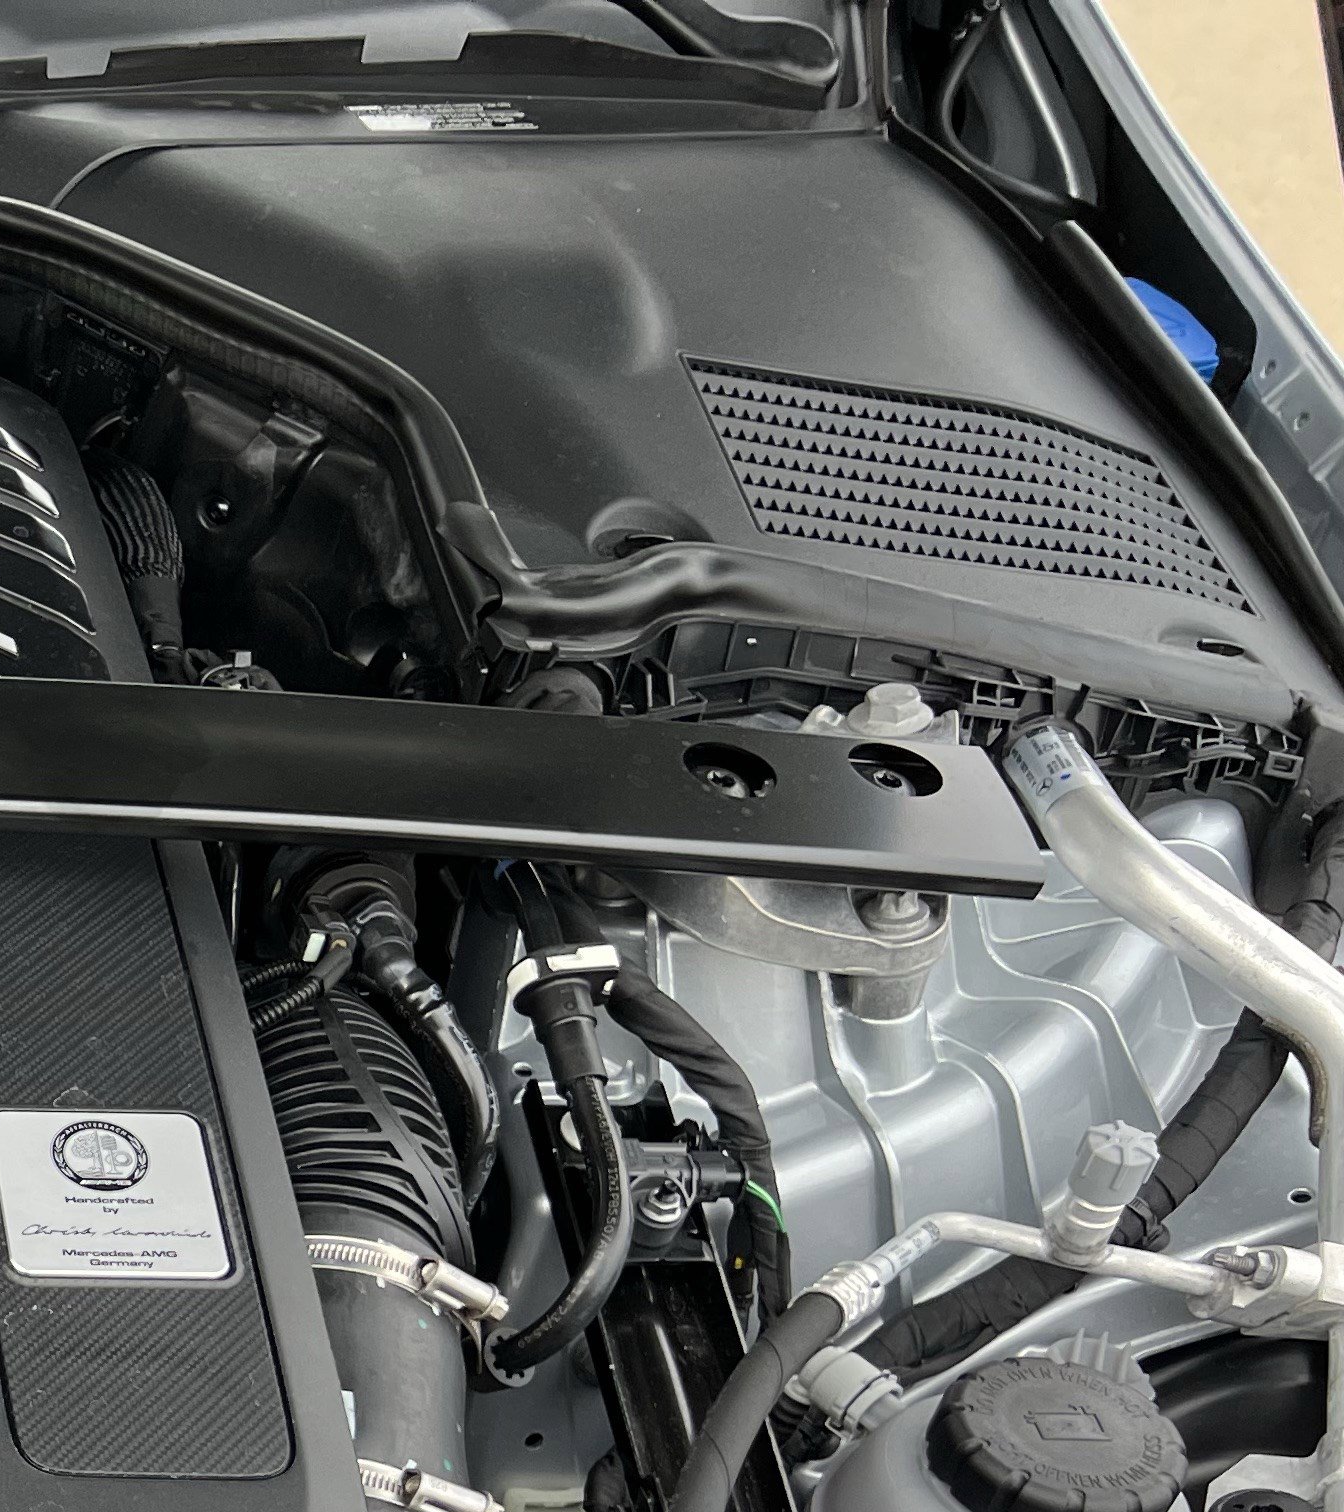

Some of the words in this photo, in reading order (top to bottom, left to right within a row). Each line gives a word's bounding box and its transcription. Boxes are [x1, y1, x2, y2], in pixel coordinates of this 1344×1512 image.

[65, 1196, 154, 1205] Handcrafted
[103, 1206, 119, 1215] by
[62, 1249, 178, 1259] Mercedes-AMG
[90, 1259, 154, 1268] Germany
